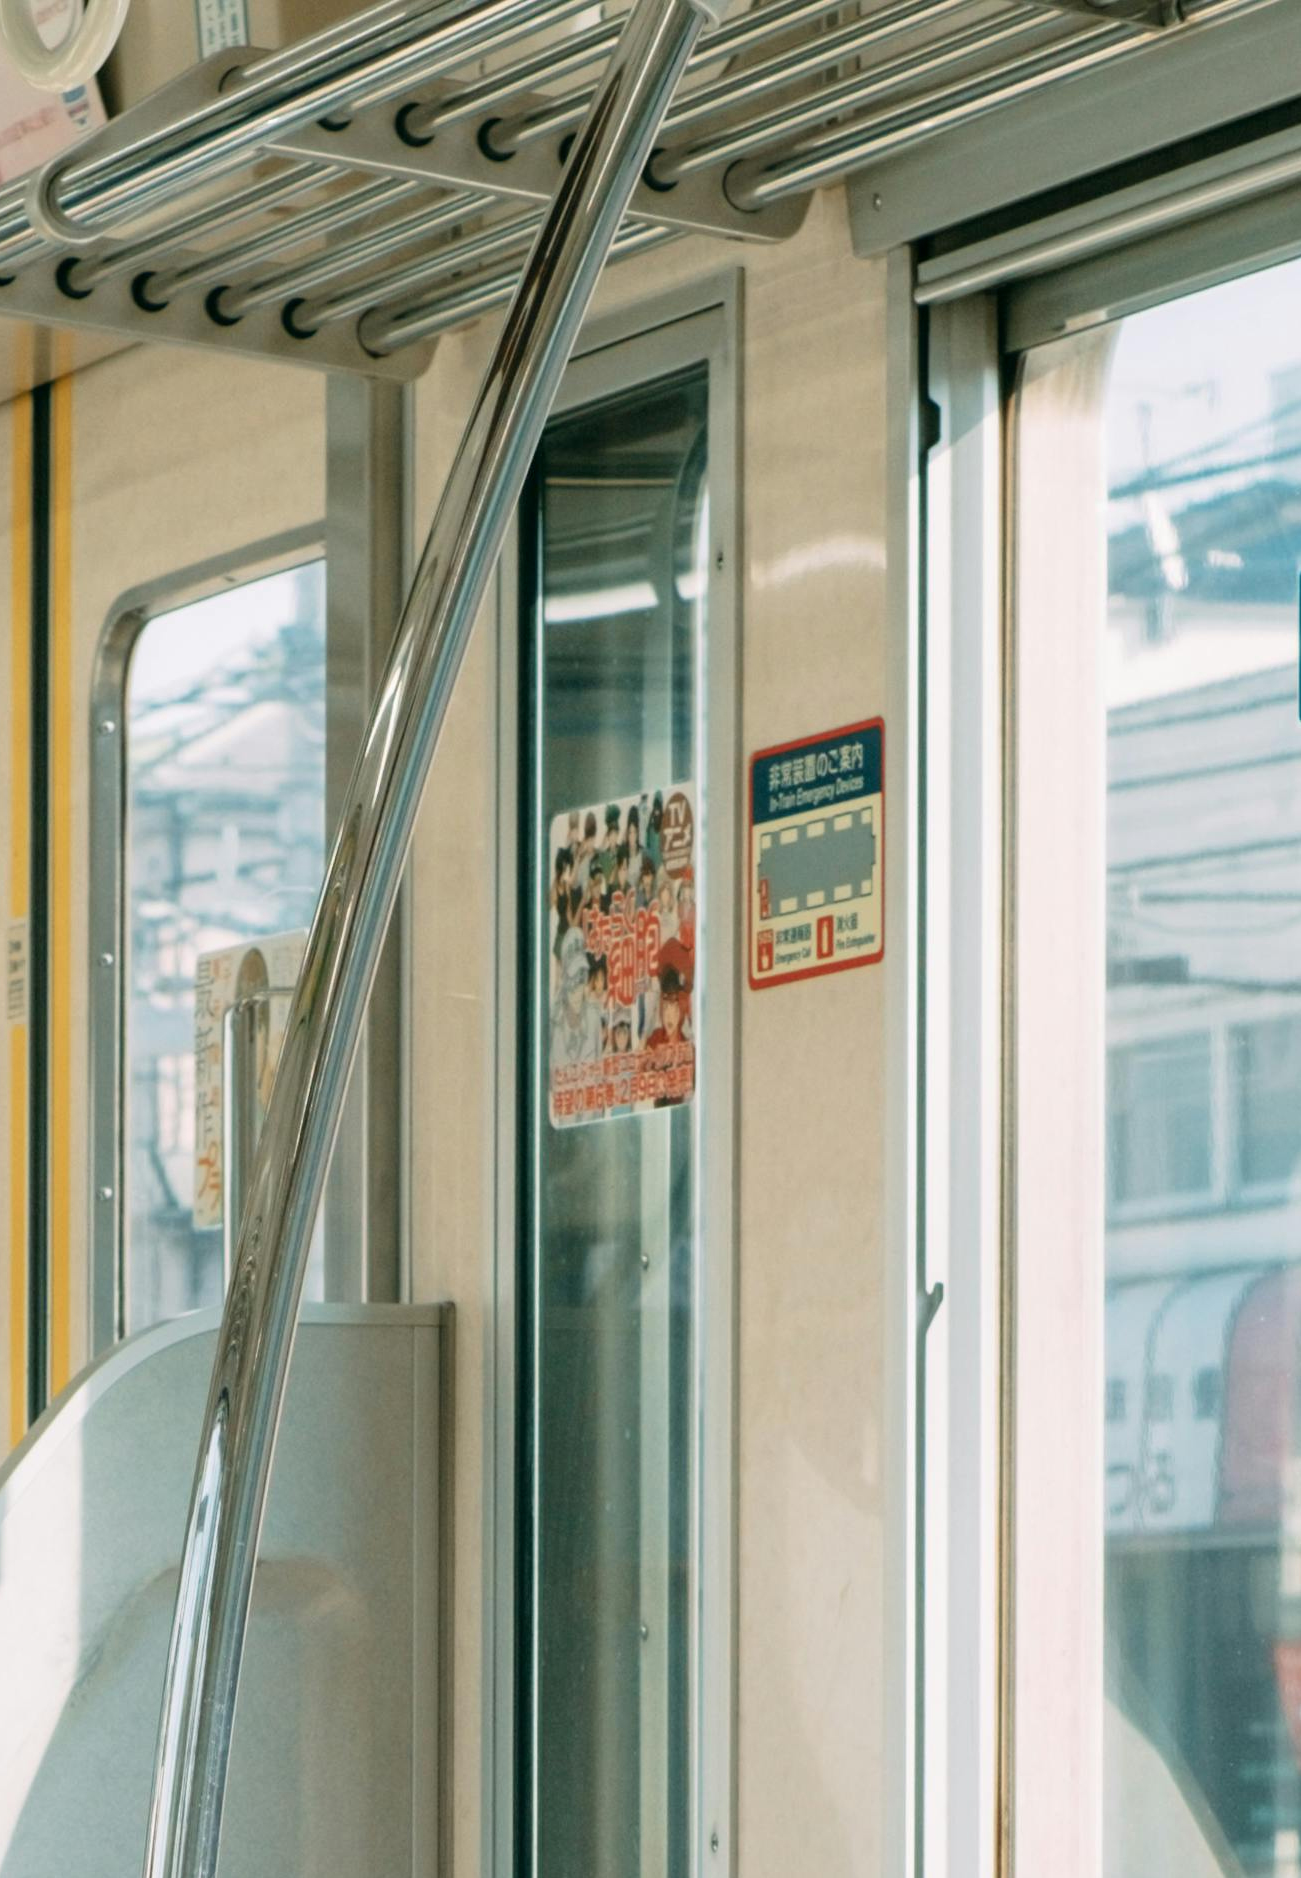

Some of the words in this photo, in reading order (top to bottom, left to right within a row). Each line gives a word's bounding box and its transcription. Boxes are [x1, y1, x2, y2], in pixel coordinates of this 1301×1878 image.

[768, 741, 864, 792] 非常装置のご案内
[796, 784, 834, 806] Emergency
[836, 774, 864, 796] Devices
[668, 802, 687, 824] TV
[604, 898, 661, 1009] 細胞
